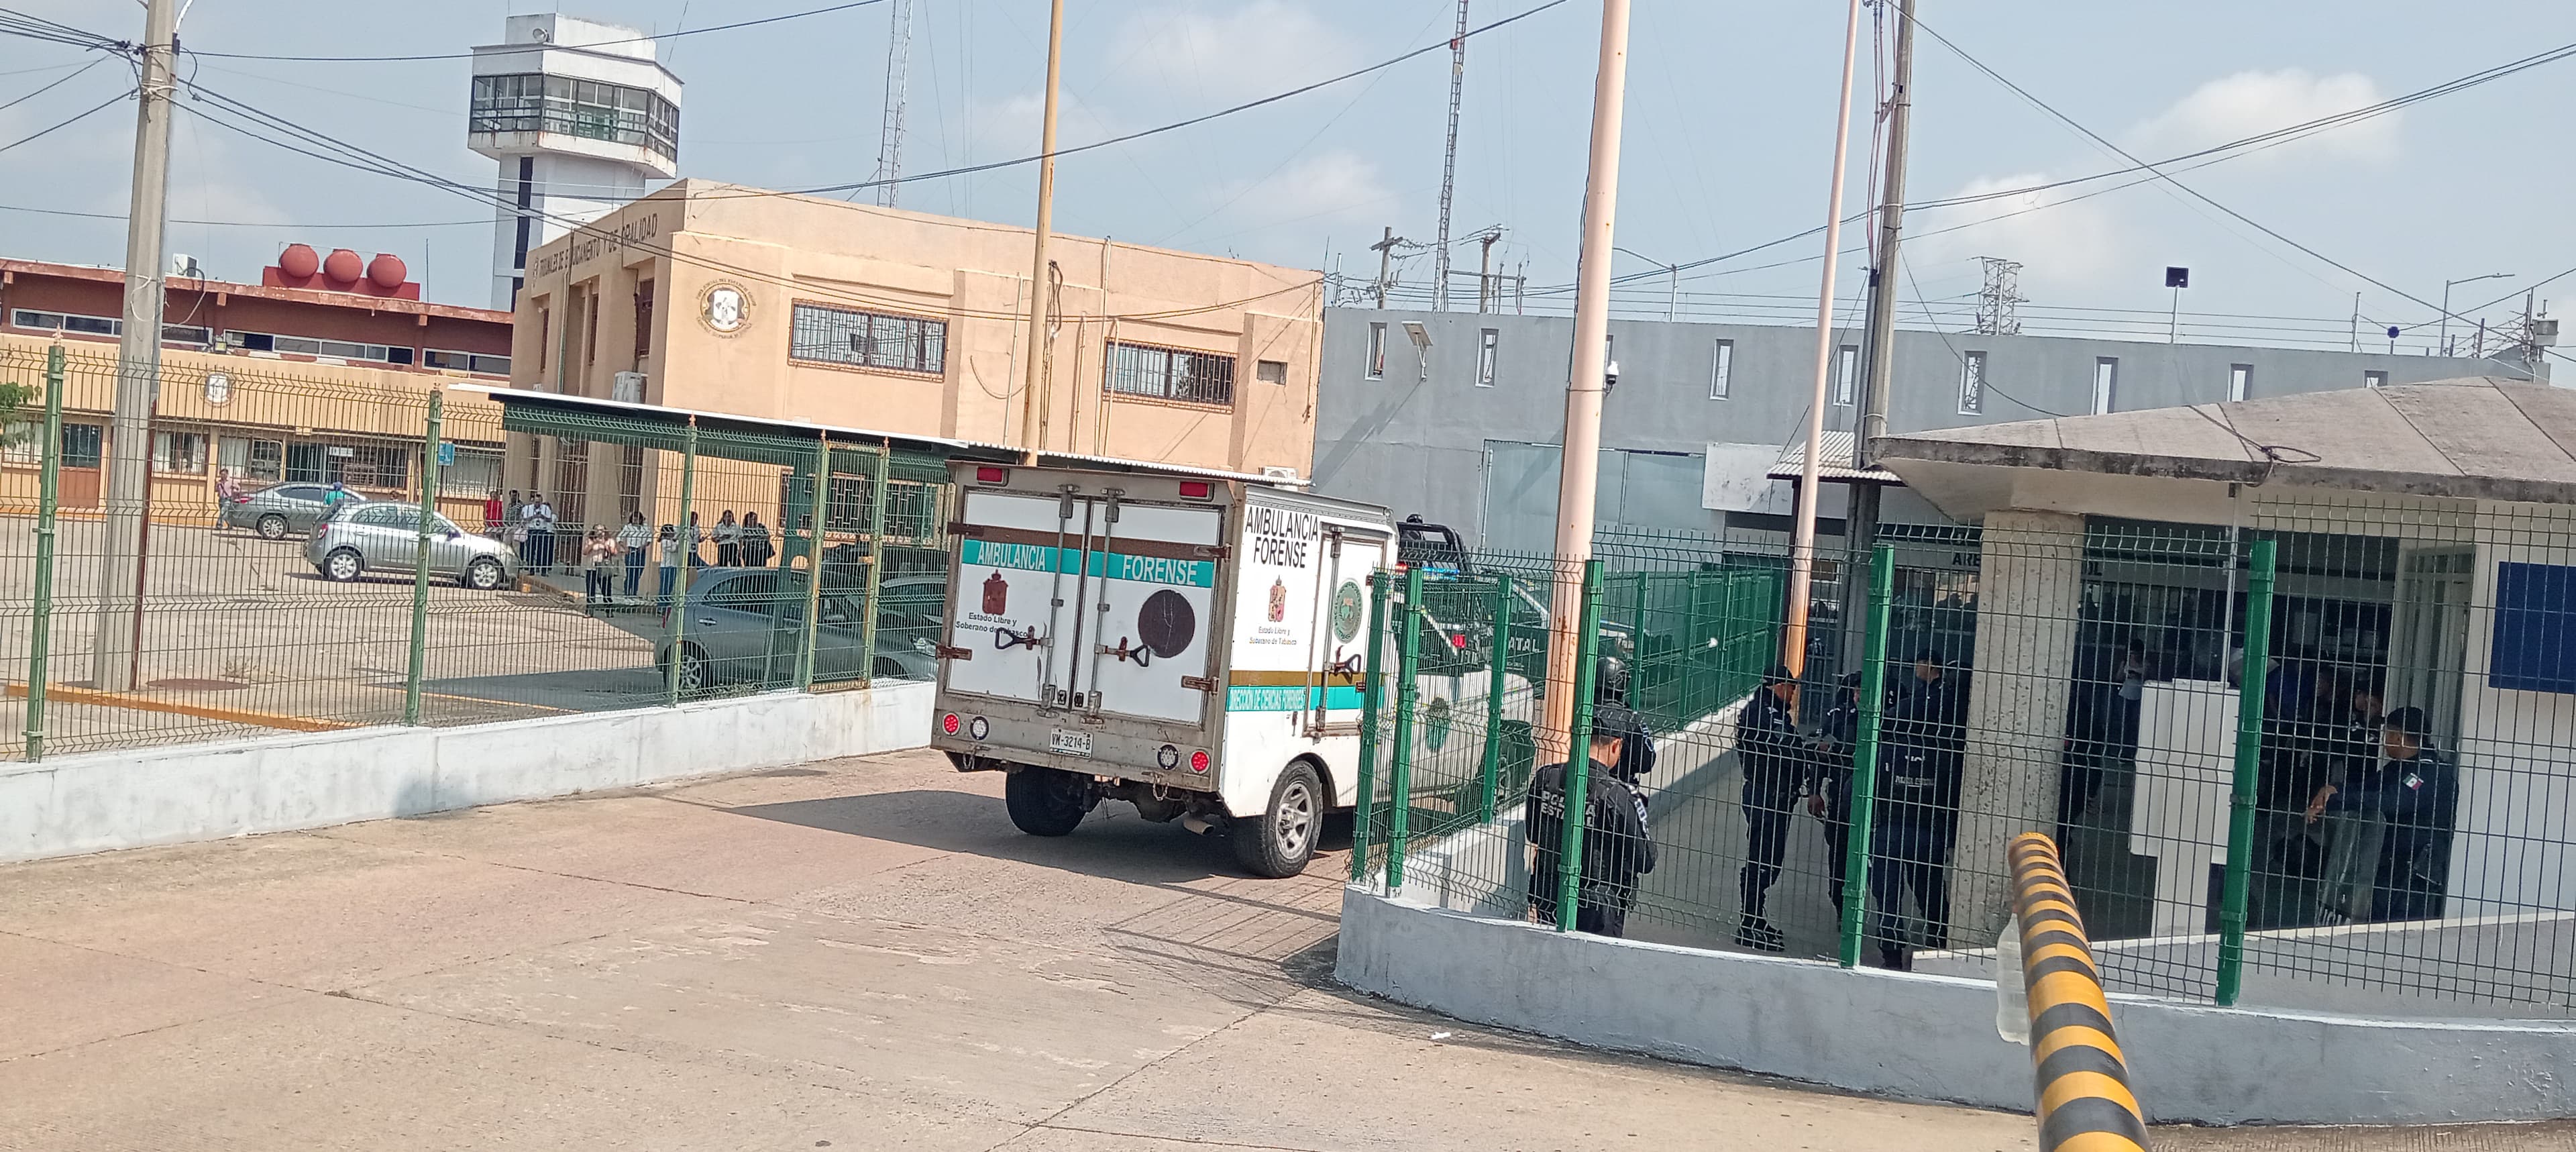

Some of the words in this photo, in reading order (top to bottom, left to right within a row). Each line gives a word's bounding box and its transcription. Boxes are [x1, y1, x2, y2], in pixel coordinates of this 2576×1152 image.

[1245, 506, 1318, 541] AMBULANCIA
[977, 541, 1045, 570] AMBULANCIA
[1122, 555, 1198, 586] FORENSE
[1253, 536, 1307, 568] FORENSE
[955, 621, 987, 631] Soberano
[969, 612, 991, 622] Estado
[994, 616, 1010, 625] Libre
[1509, 636, 1540, 652] ATAL
